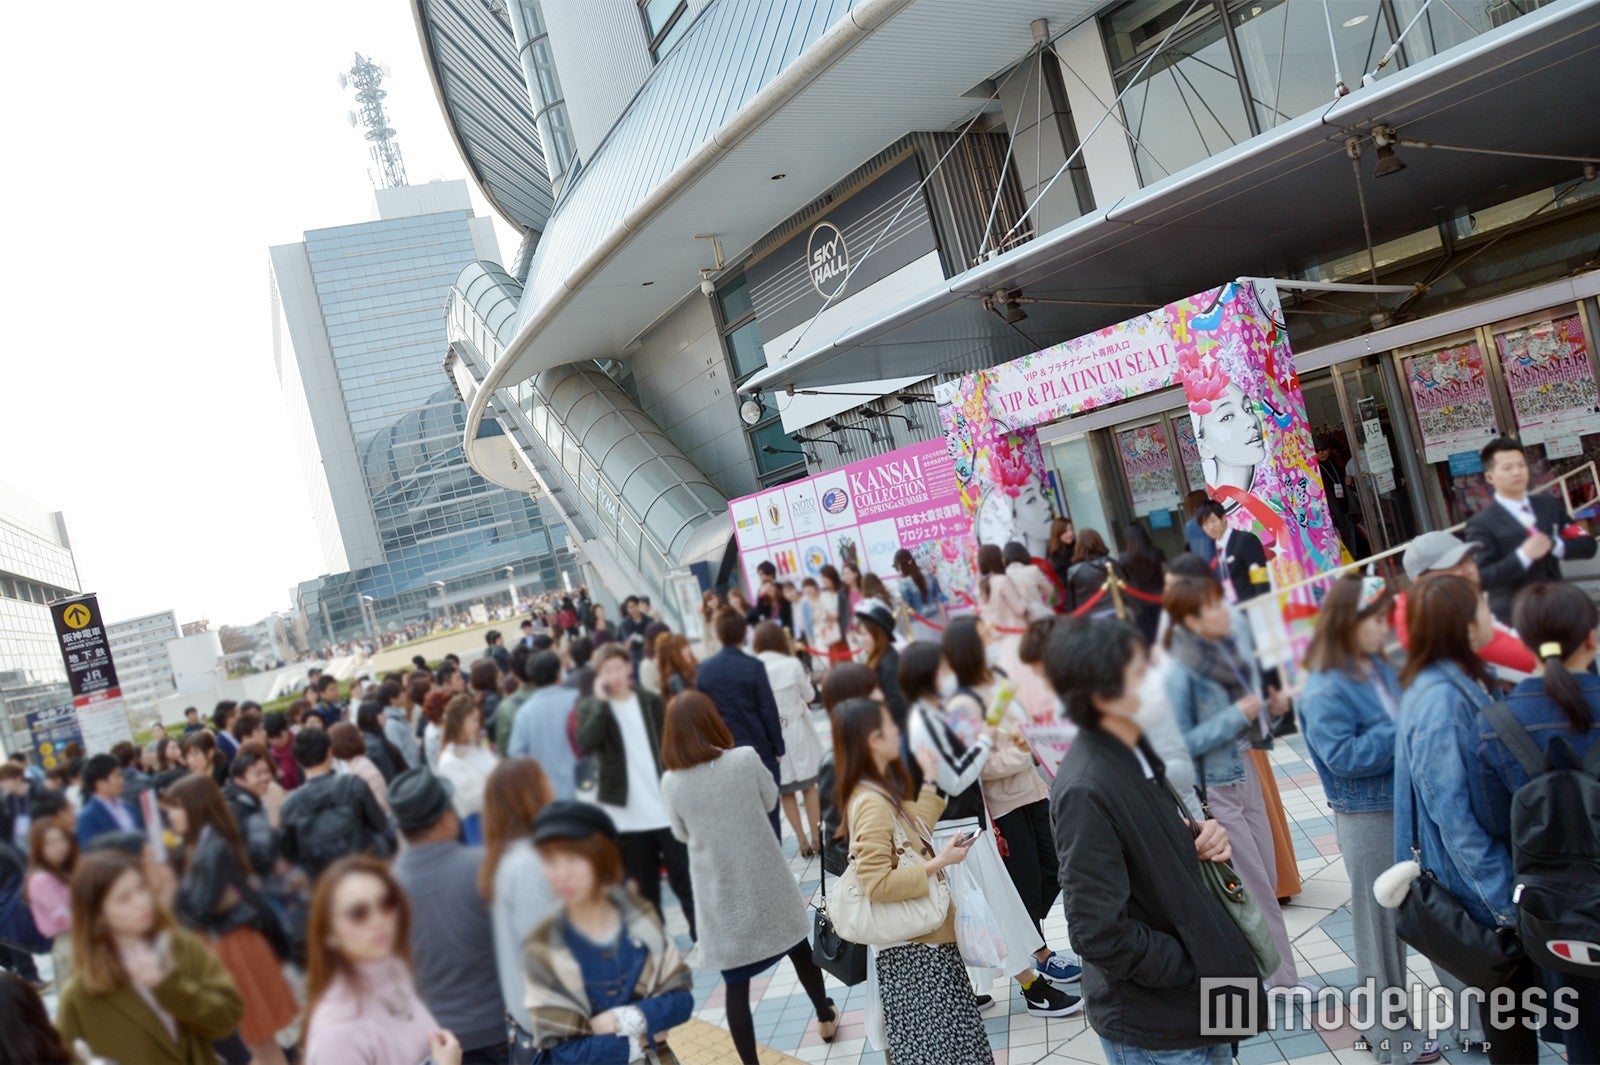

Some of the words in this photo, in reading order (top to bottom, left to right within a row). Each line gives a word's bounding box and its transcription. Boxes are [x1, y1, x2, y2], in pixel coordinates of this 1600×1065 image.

[809, 233, 839, 271] SKY
[814, 255, 848, 288] HALL
[1023, 371, 1039, 382] VIP
[1040, 368, 1047, 377] &
[1048, 340, 1131, 374] プラチナシート専用入口
[998, 390, 1023, 414] VIP
[1027, 386, 1039, 407] &
[1040, 359, 1124, 402] PLATINUM
[1125, 343, 1171, 377] SEAT
[849, 455, 924, 496] KANSAI
[854, 478, 927, 509] COLLECTION
[896, 503, 961, 529] 東日本大震災復興
[62, 627, 101, 643] 阪神電車
[82, 669, 102, 683] JR
